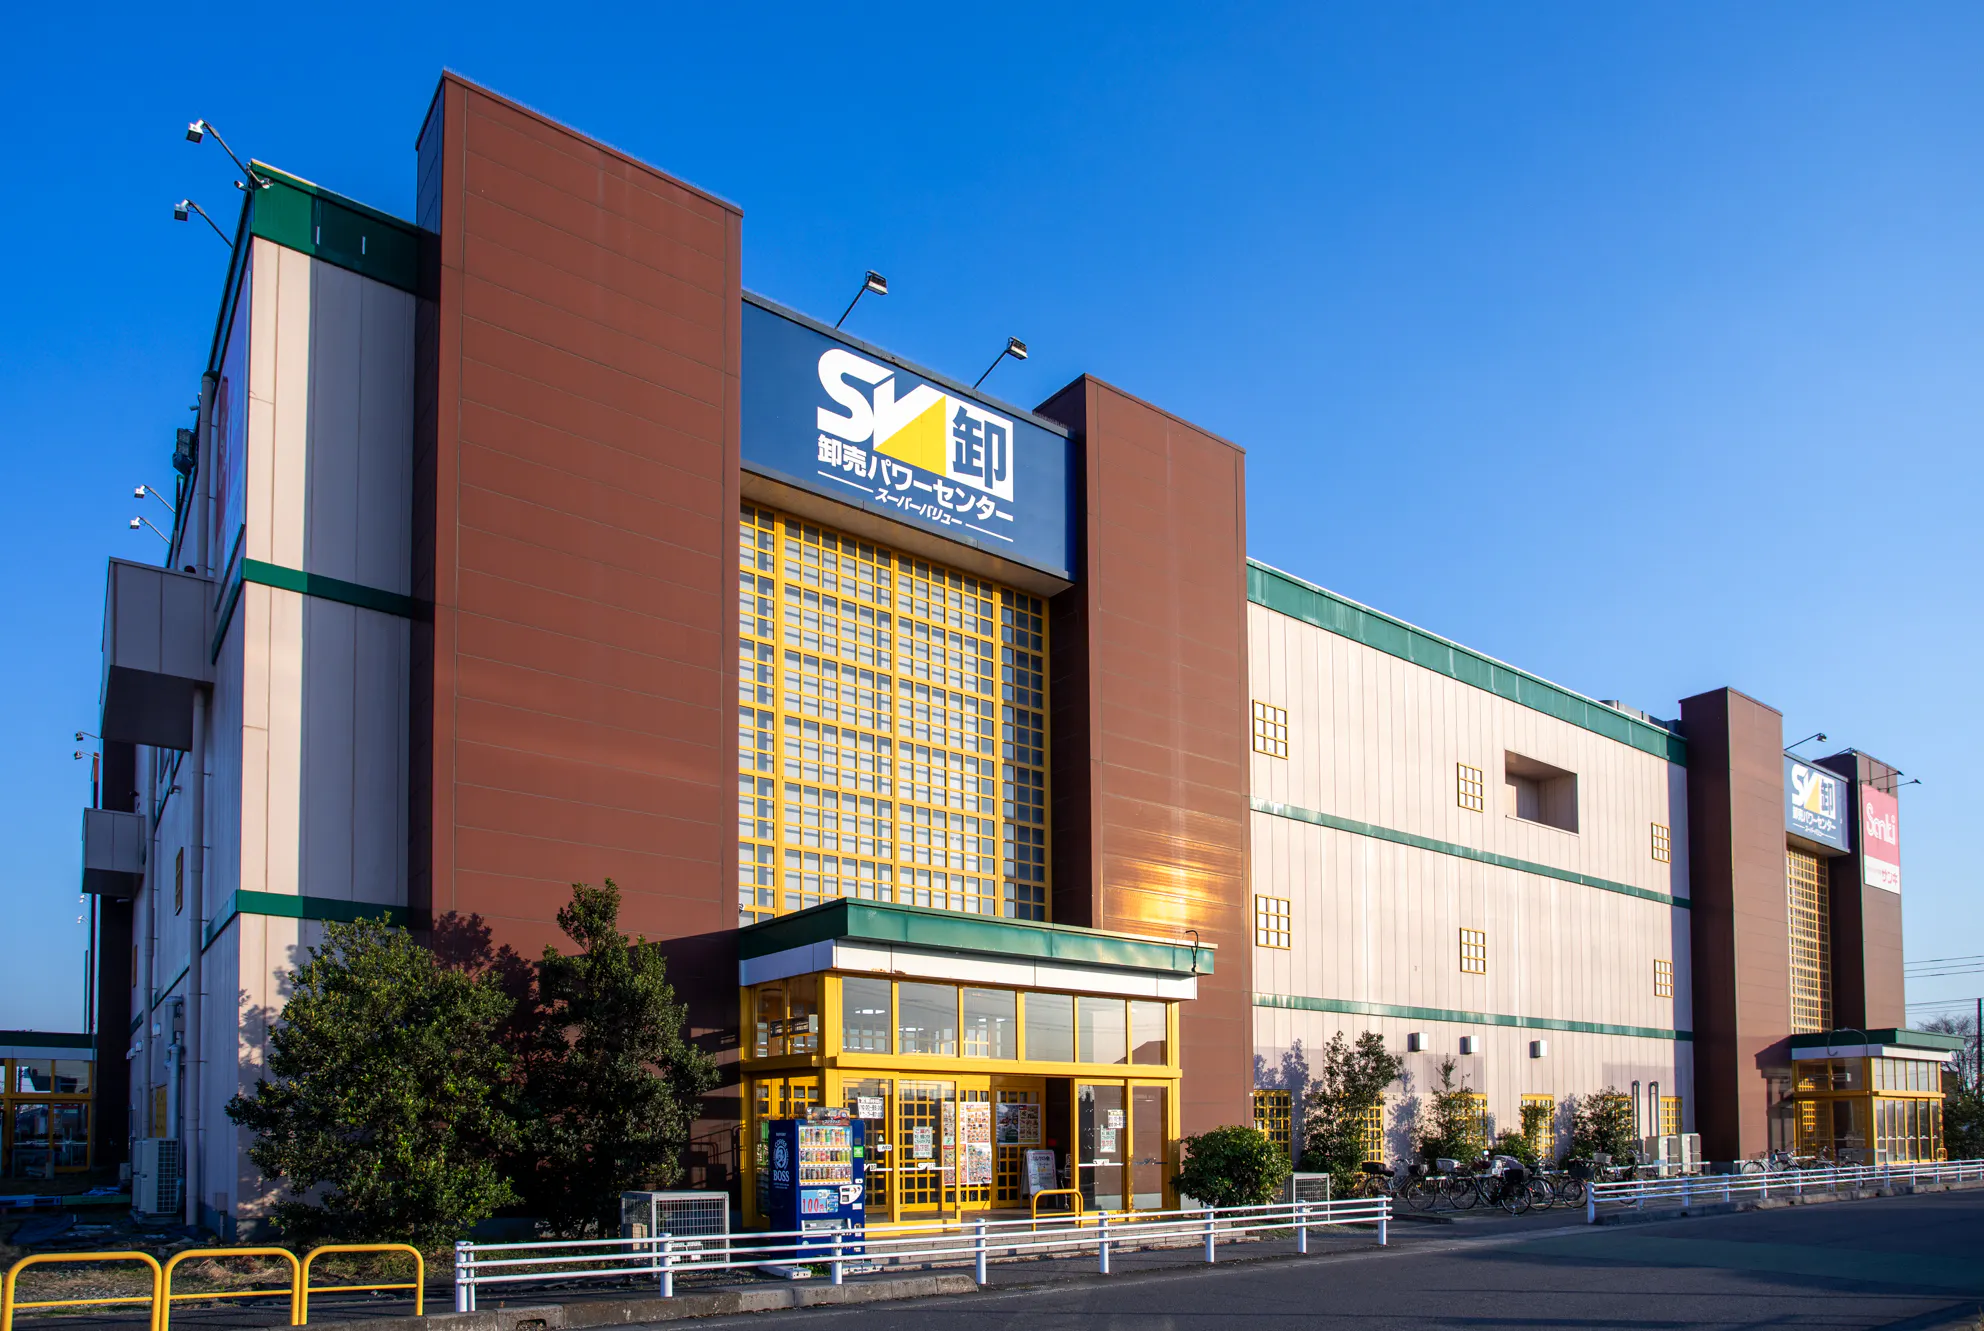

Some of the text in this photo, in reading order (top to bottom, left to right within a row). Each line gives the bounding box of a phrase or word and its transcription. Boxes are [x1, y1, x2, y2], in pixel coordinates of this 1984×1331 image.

[953, 406, 1007, 489] 卸
[817, 434, 1014, 523] 卸売パワーセンター
[875, 486, 963, 526] スーパーバリュー
[773, 1170, 790, 1182] BOSS
